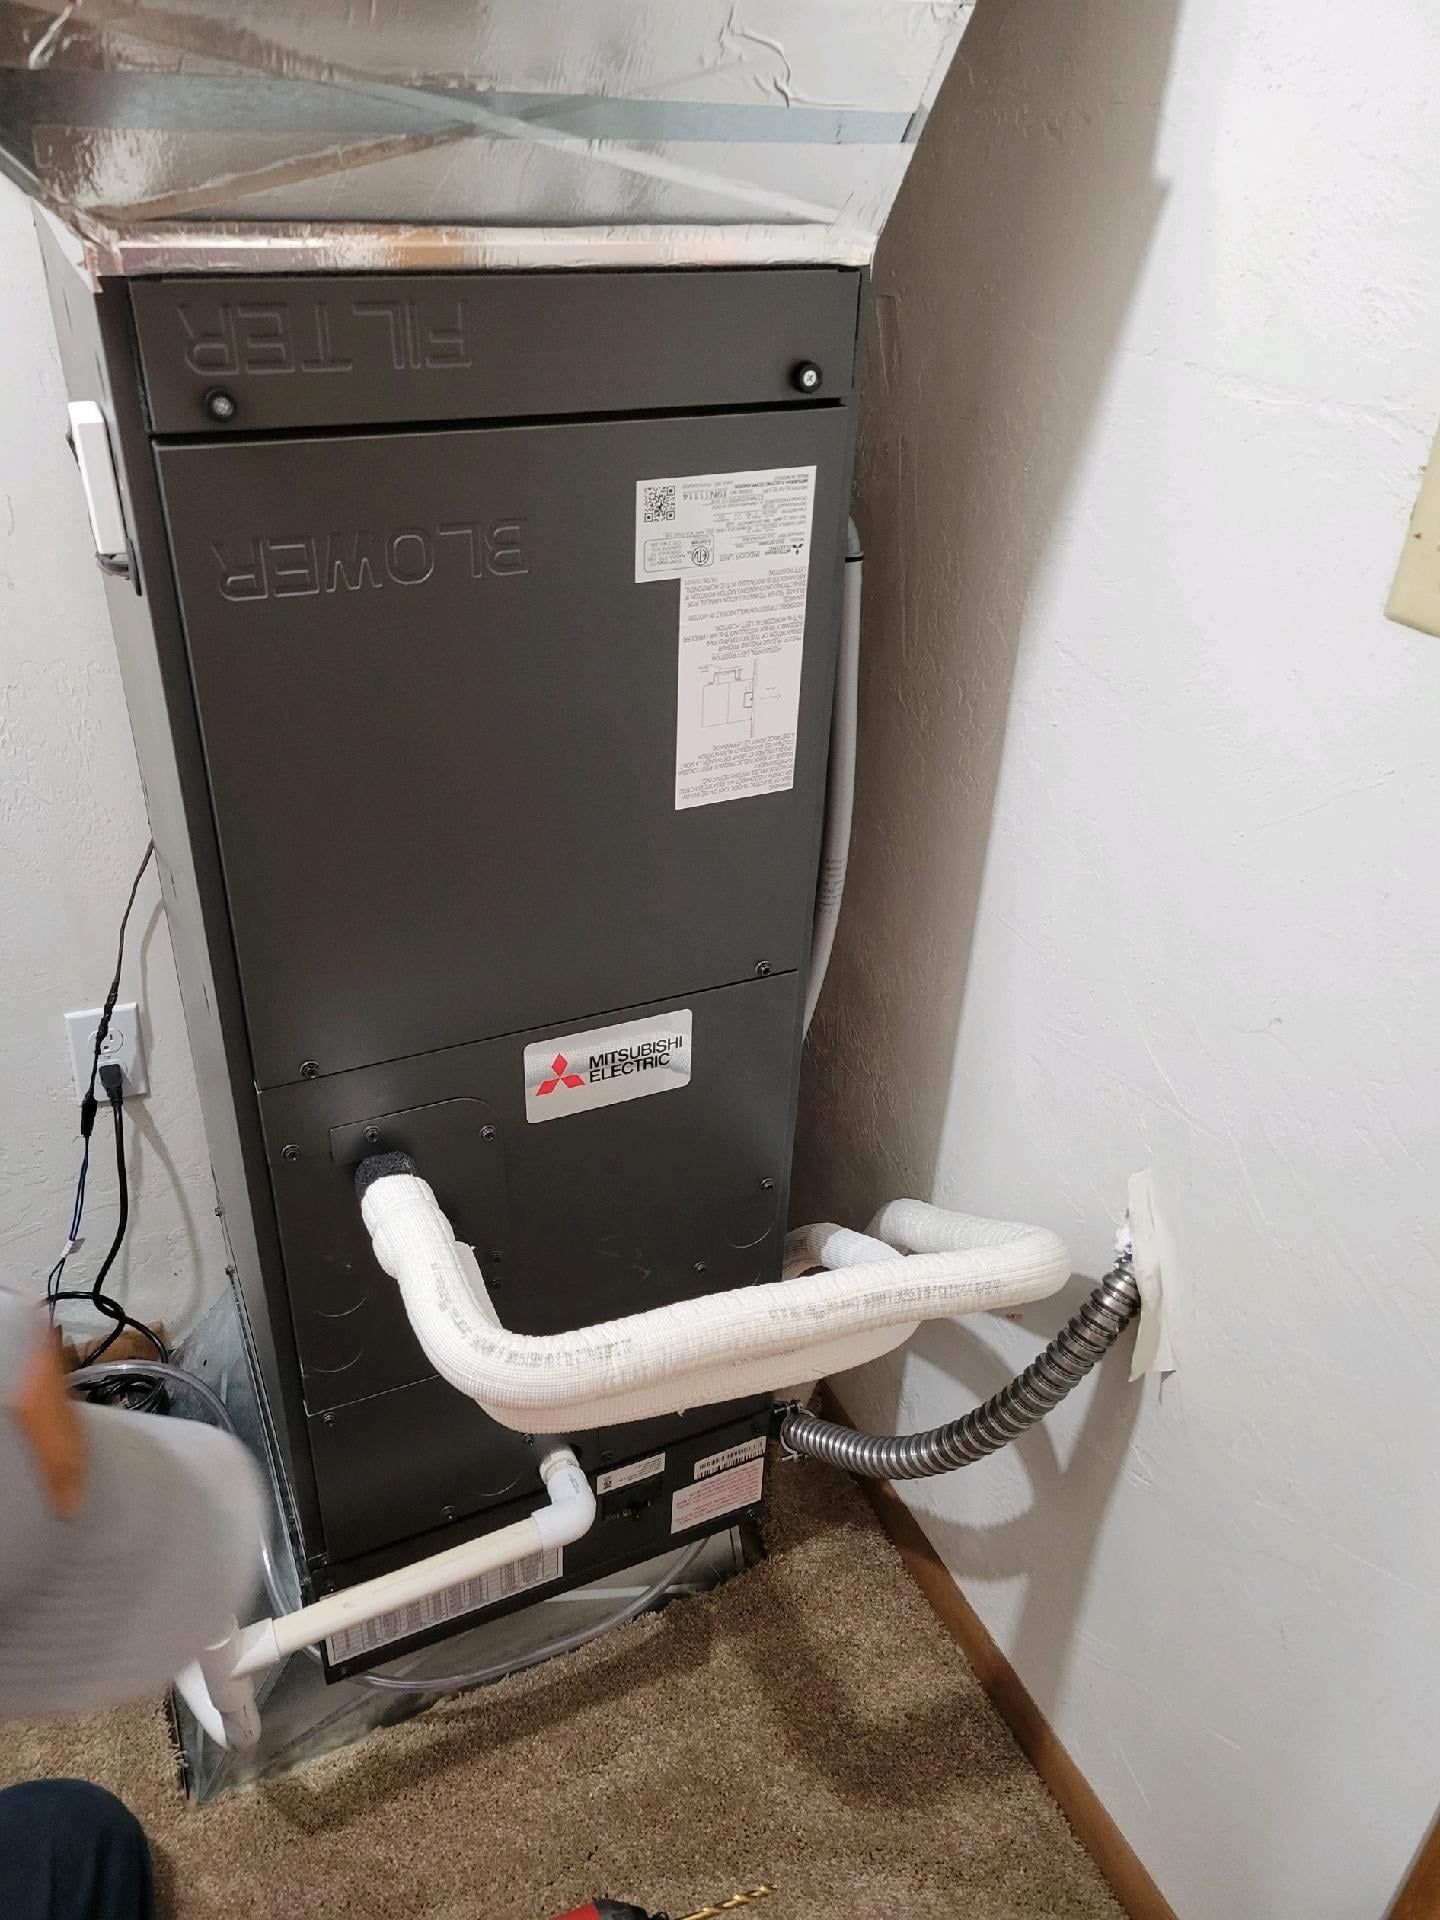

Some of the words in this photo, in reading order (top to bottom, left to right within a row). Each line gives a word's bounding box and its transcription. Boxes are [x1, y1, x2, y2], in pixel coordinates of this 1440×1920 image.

[177, 298, 472, 378] FILTER
[209, 516, 530, 602] BLOWER
[589, 1035, 683, 1070] MITSUBISHI
[590, 1052, 671, 1083] ELECTRIC
